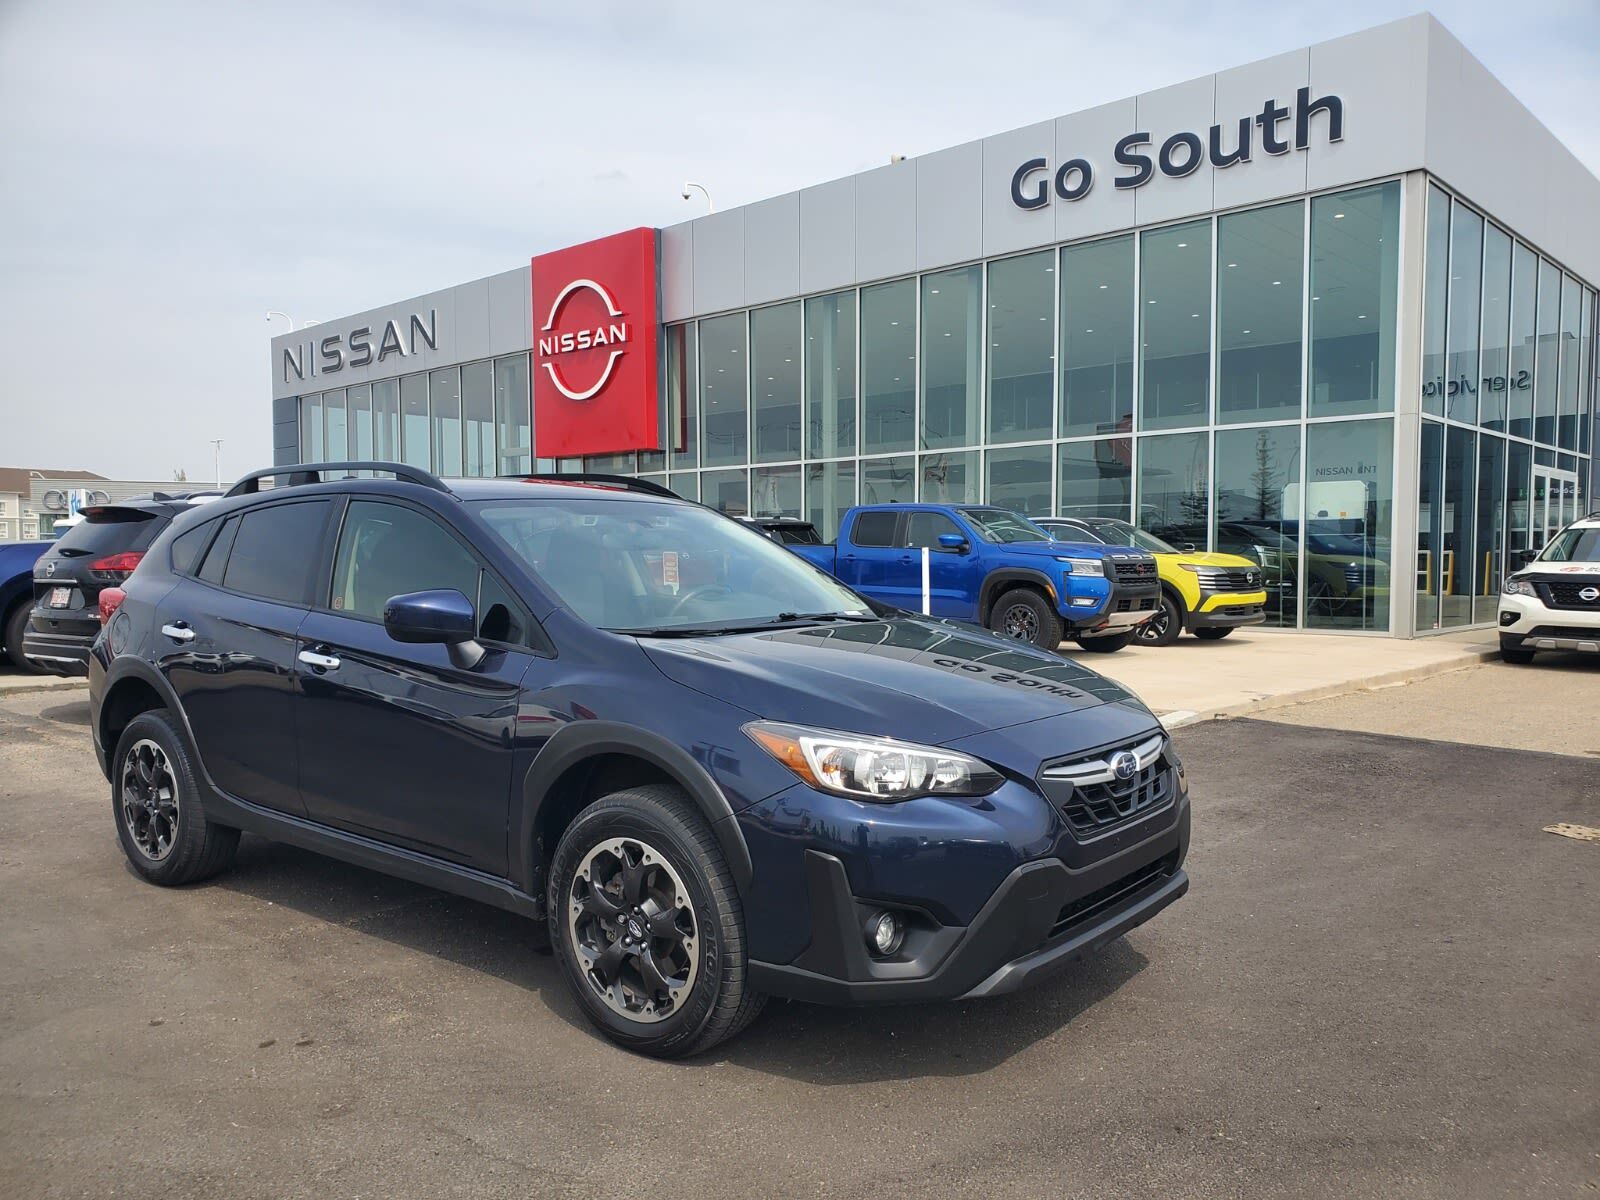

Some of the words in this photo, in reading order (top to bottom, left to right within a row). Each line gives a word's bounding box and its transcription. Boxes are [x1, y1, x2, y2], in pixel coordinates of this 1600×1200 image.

[1010, 157, 1095, 211] Go
[1113, 86, 1344, 189] South
[283, 308, 438, 383] NISSAN
[539, 322, 627, 357] NISSAN
[1315, 467, 1353, 476] NISSAN
